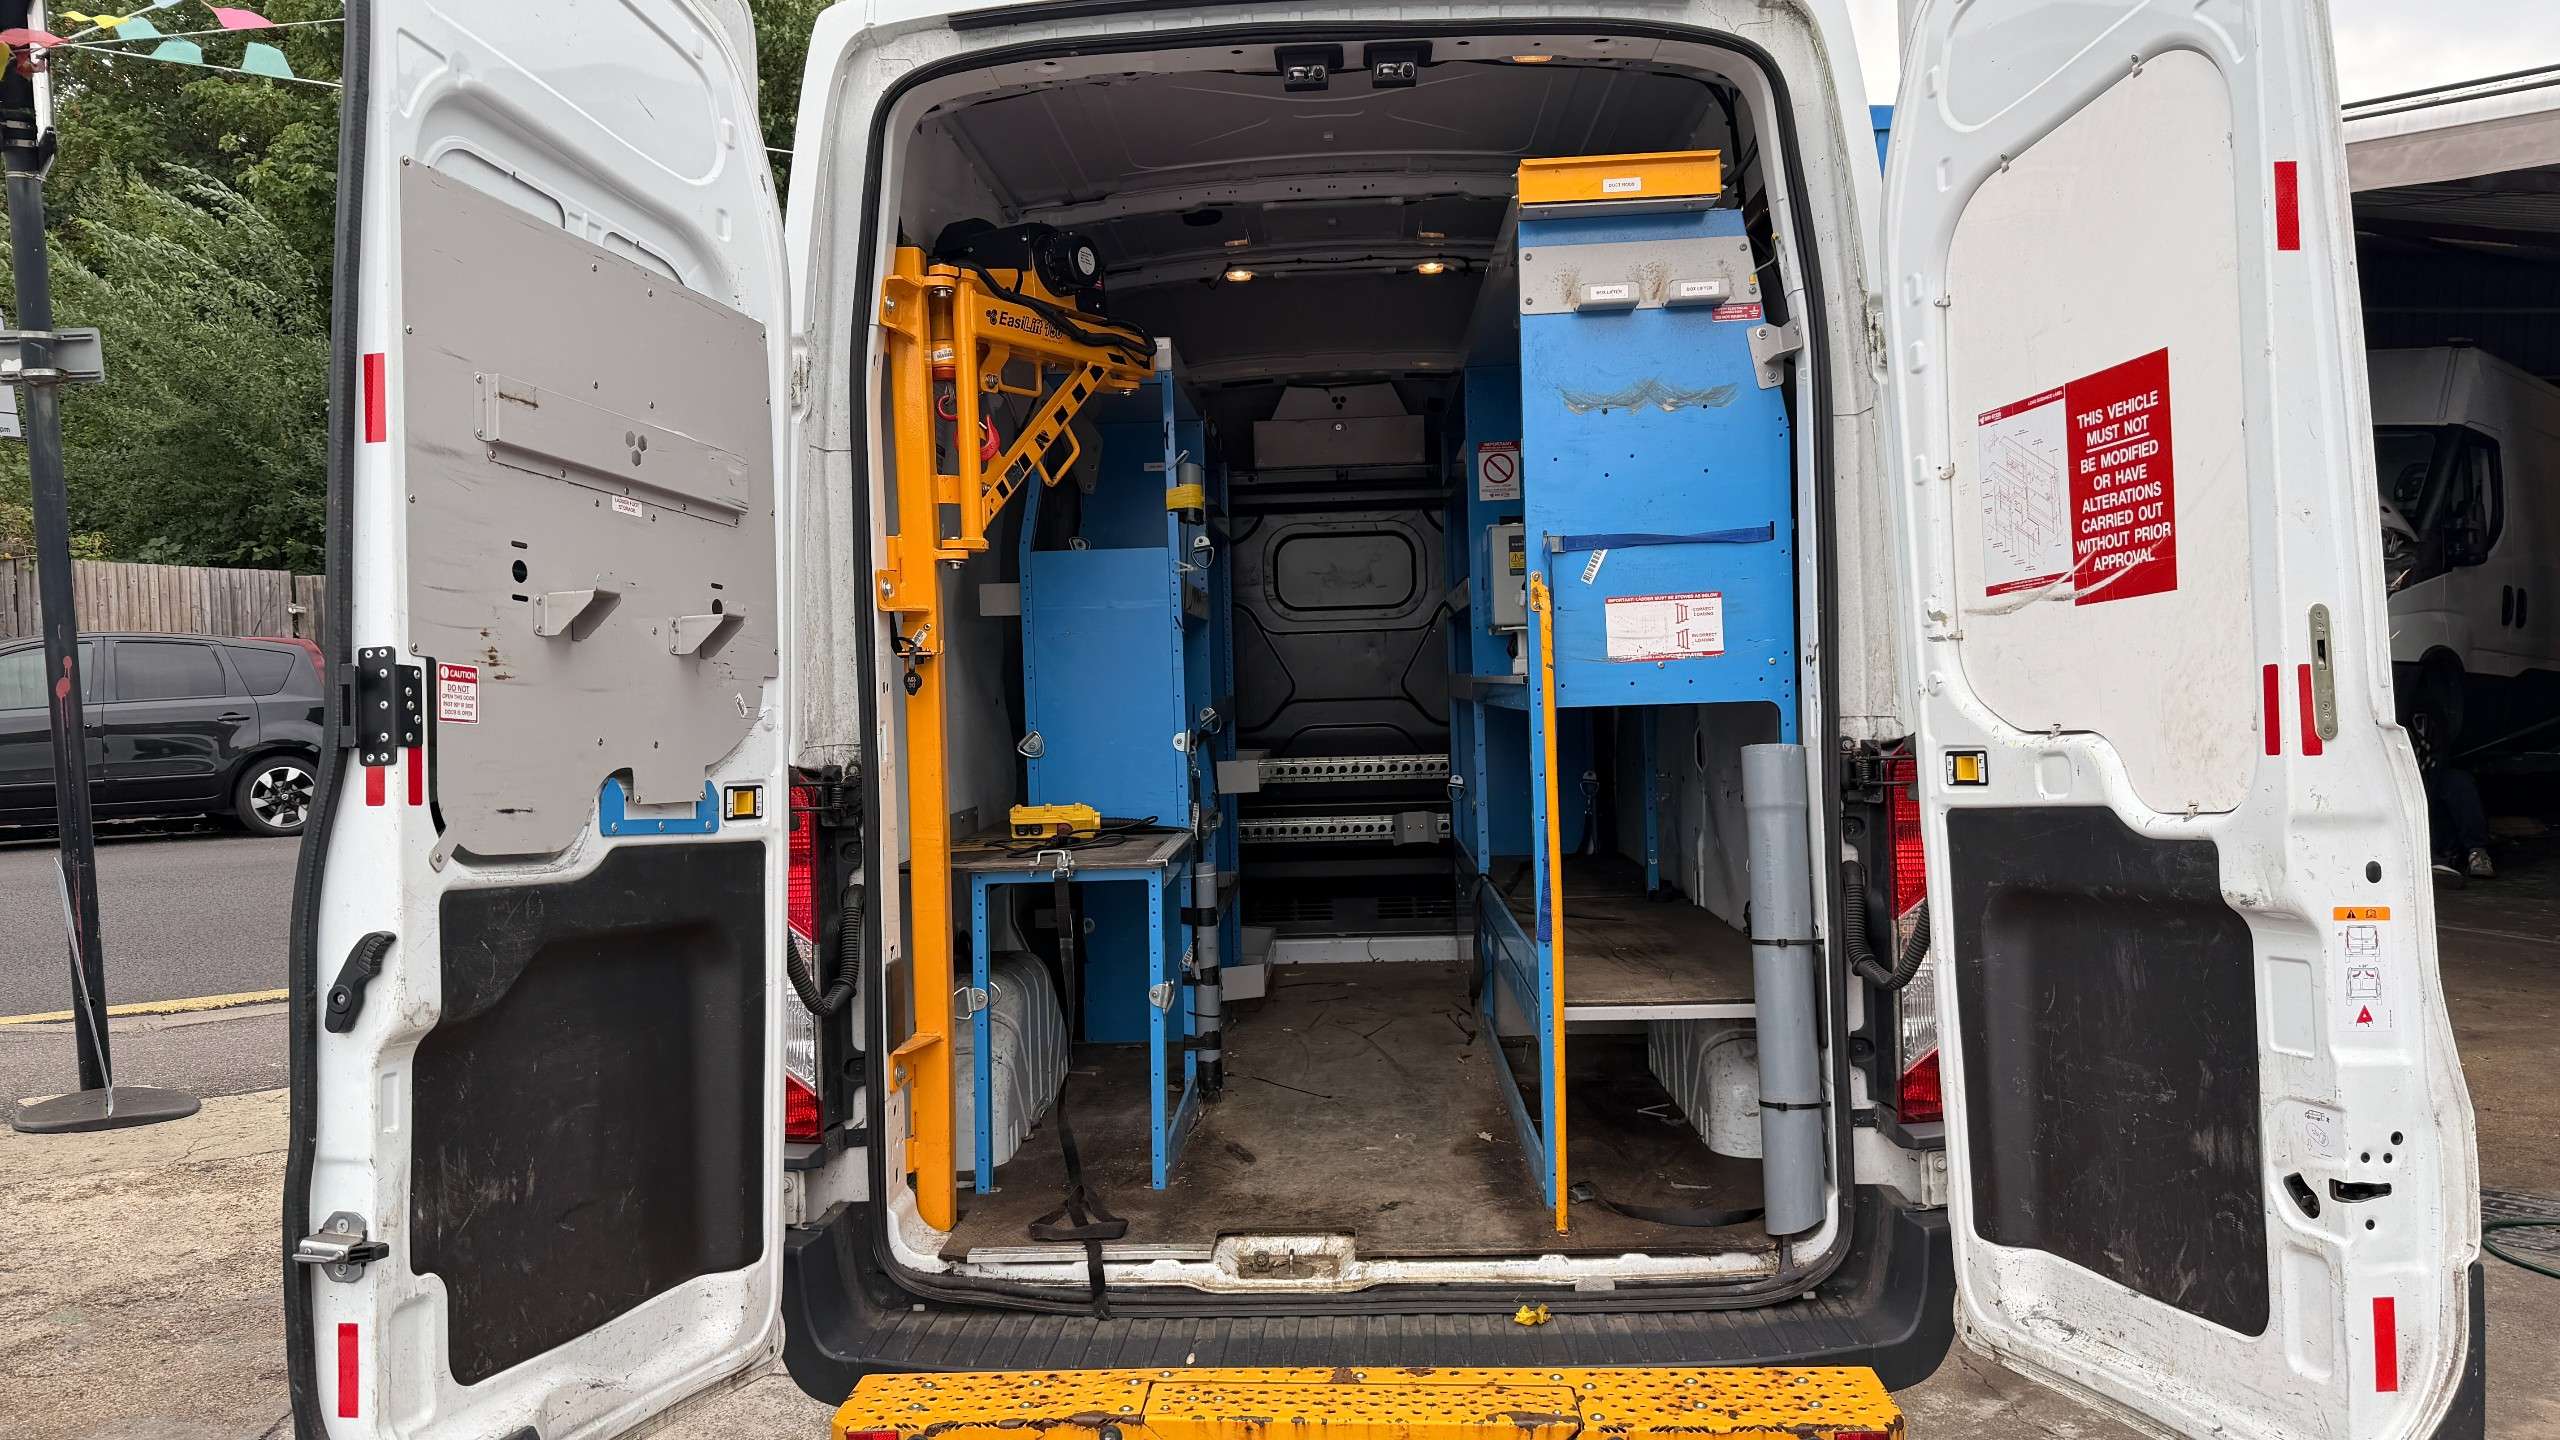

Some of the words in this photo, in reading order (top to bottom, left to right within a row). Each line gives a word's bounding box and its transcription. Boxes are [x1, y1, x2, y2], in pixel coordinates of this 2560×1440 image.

[999, 311, 1043, 336] EasiLift
[2077, 408, 2104, 430] THIS
[2106, 390, 2159, 420] VEHICLE
[2086, 423, 2120, 447] MUST
[2124, 414, 2150, 435] NOT
[2080, 456, 2097, 474] BE
[2100, 439, 2159, 469] MODIFIED
[2093, 473, 2111, 491] OR
[2115, 463, 2147, 486] HAVE
[2082, 480, 2162, 514] ALTERATIONS
[2081, 509, 2134, 534] CARRIED
[2138, 501, 2164, 521] OUT
[2076, 530, 2130, 555] WITHOUT
[2134, 521, 2172, 544] PRIOR
[2093, 546, 2156, 572] APPROVAL
[447, 683, 457, 692] DO
[457, 684, 470, 693] NOT
[449, 669, 477, 680] CAUTION
